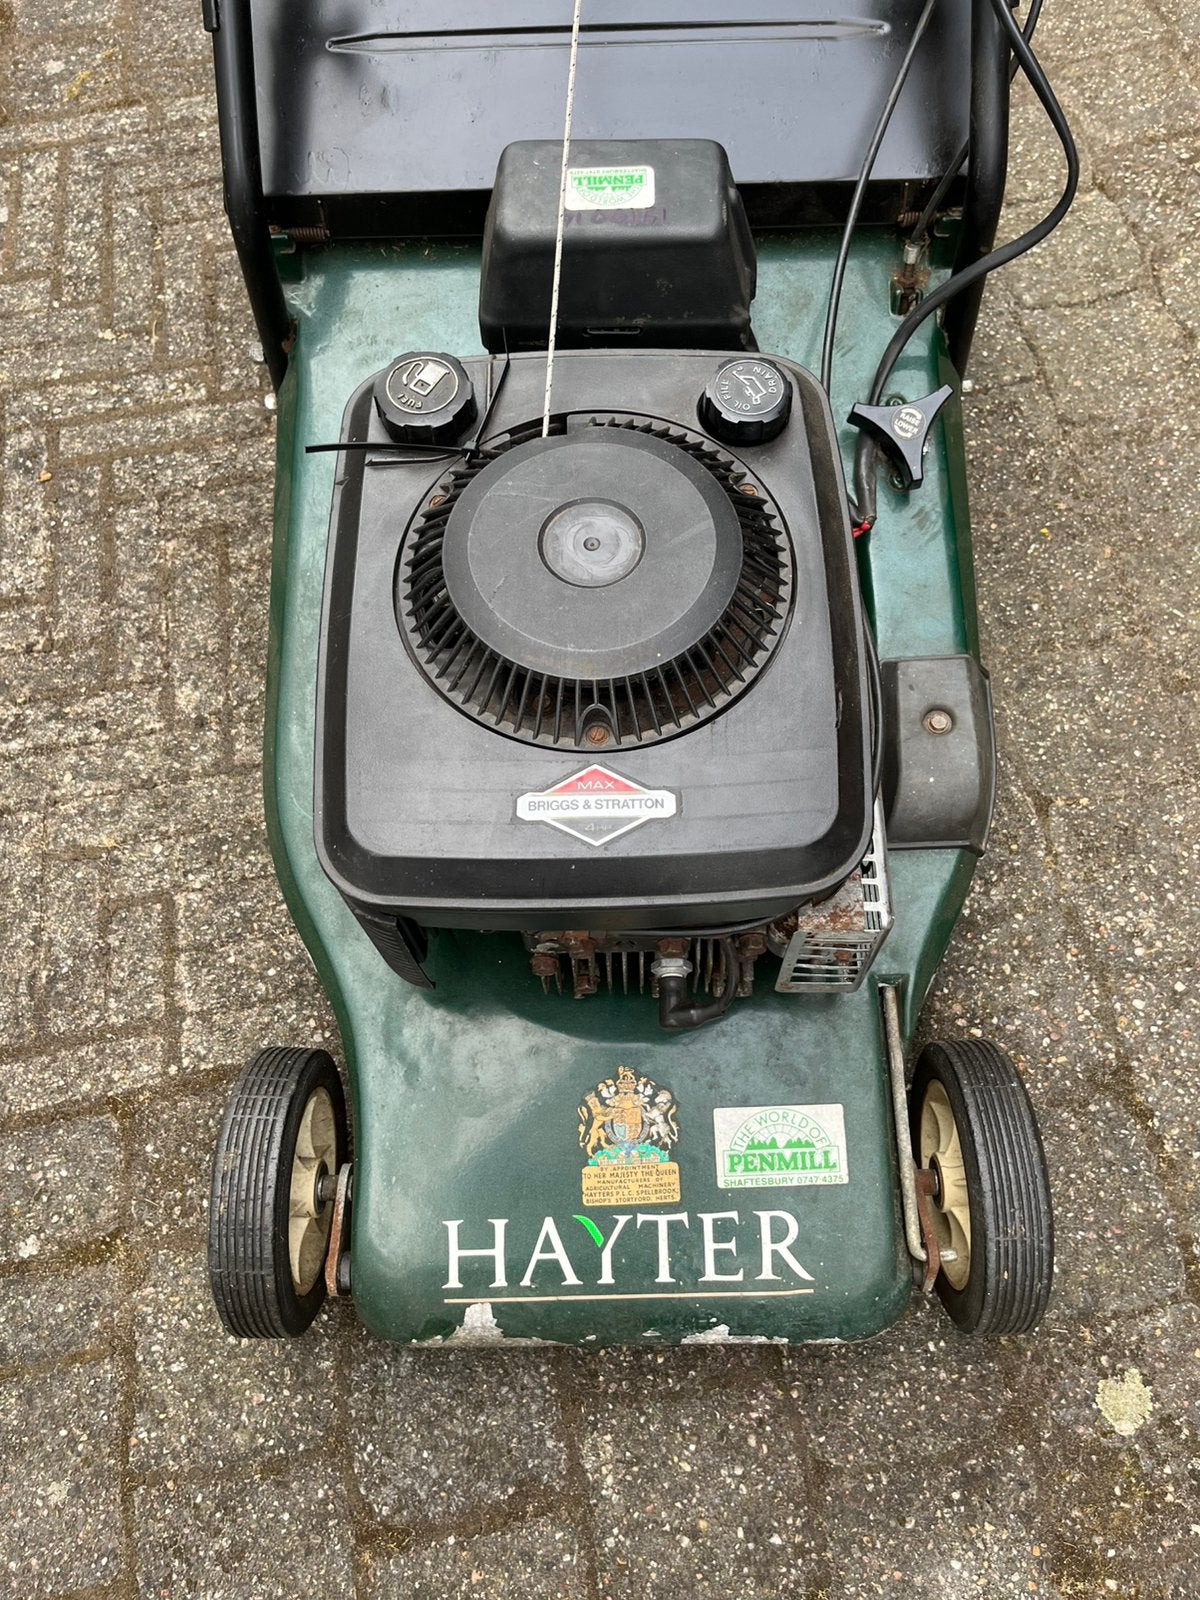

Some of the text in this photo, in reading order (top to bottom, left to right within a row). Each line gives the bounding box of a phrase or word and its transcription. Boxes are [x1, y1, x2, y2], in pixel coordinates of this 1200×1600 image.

[573, 175, 644, 186] PENMILL
[752, 366, 777, 393] DRAIN
[397, 393, 423, 409] FUEL
[721, 380, 750, 410] OIL FILL
[895, 419, 918, 434] LOWER
[900, 413, 920, 426] RAISE
[577, 780, 615, 790] MAX
[528, 798, 665, 812] BRIGGS & STRATTON
[733, 1111, 826, 1148] THE WORLD OF
[728, 1150, 837, 1173] PENMILL
[724, 1175, 844, 1187] SHAFTESBURY 0747 4375
[441, 1211, 815, 1289] HAYTER
